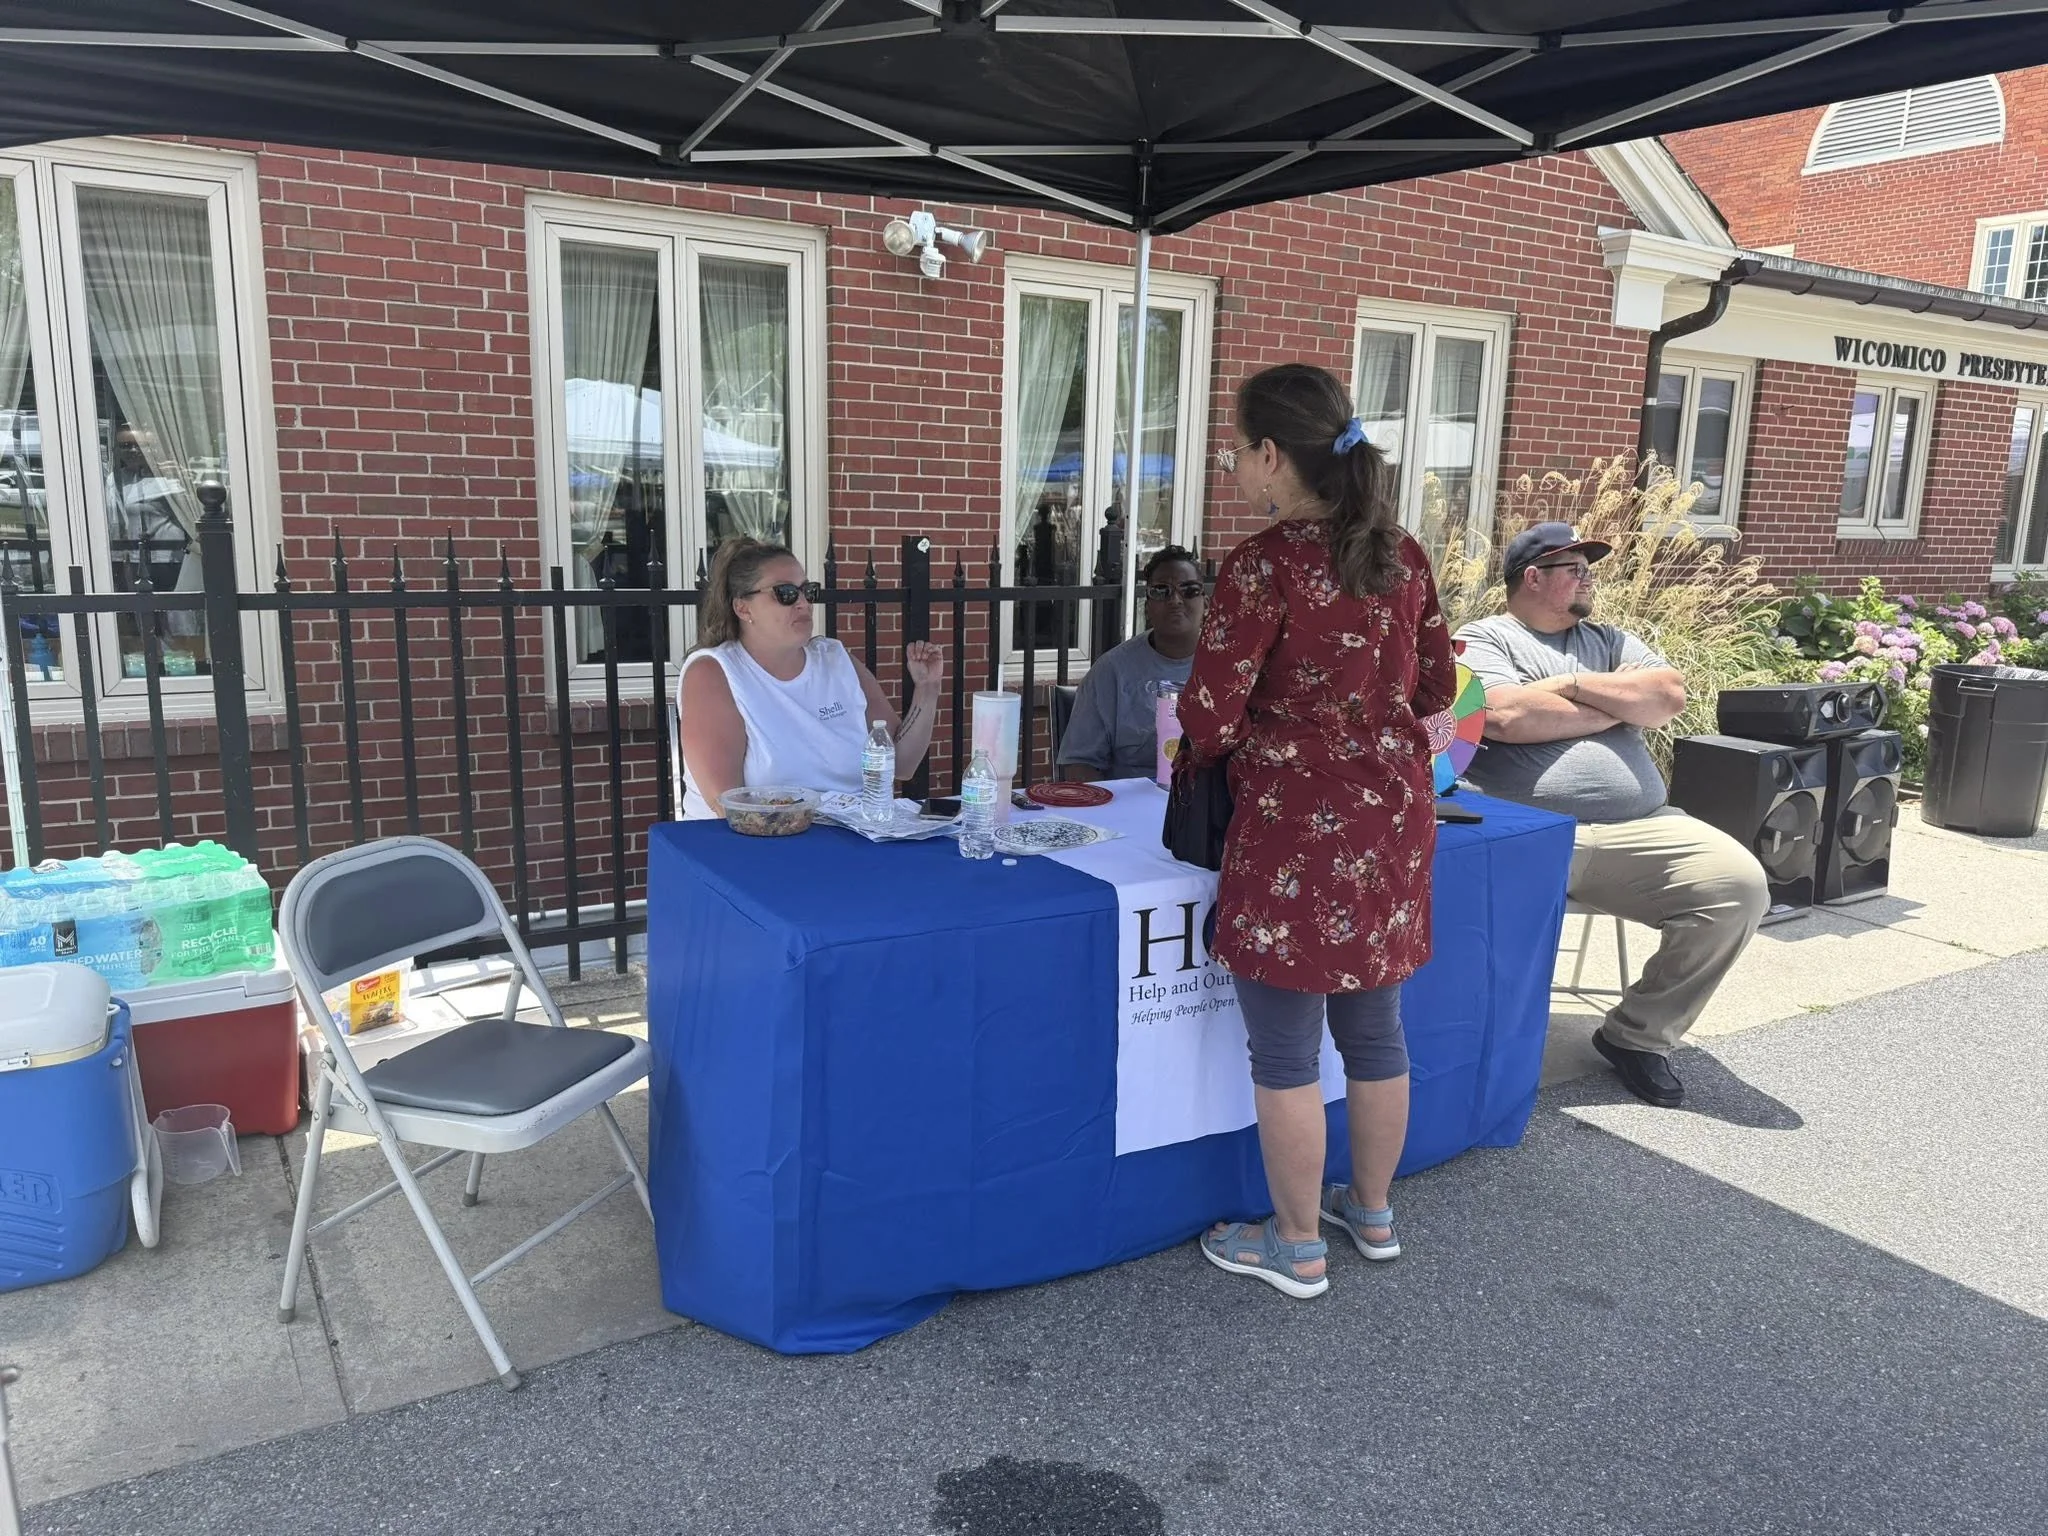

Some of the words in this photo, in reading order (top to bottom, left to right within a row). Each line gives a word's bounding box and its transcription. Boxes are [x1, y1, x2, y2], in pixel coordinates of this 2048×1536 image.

[1834, 336, 1947, 373] WICOMICO
[1957, 352, 2048, 386] PRESBYTE
[29, 935, 47, 946] 40
[181, 925, 238, 950] RECYCLE
[1131, 901, 1219, 979] H.
[95, 949, 143, 964] WATER
[1129, 983, 1167, 1003] Help
[1172, 976, 1198, 995] and
[1203, 972, 1235, 989] Out
[1131, 1008, 1173, 1025] Helping
[1174, 1000, 1208, 1017] People
[1209, 998, 1235, 1012] Open
[0, 1173, 53, 1207] ER
